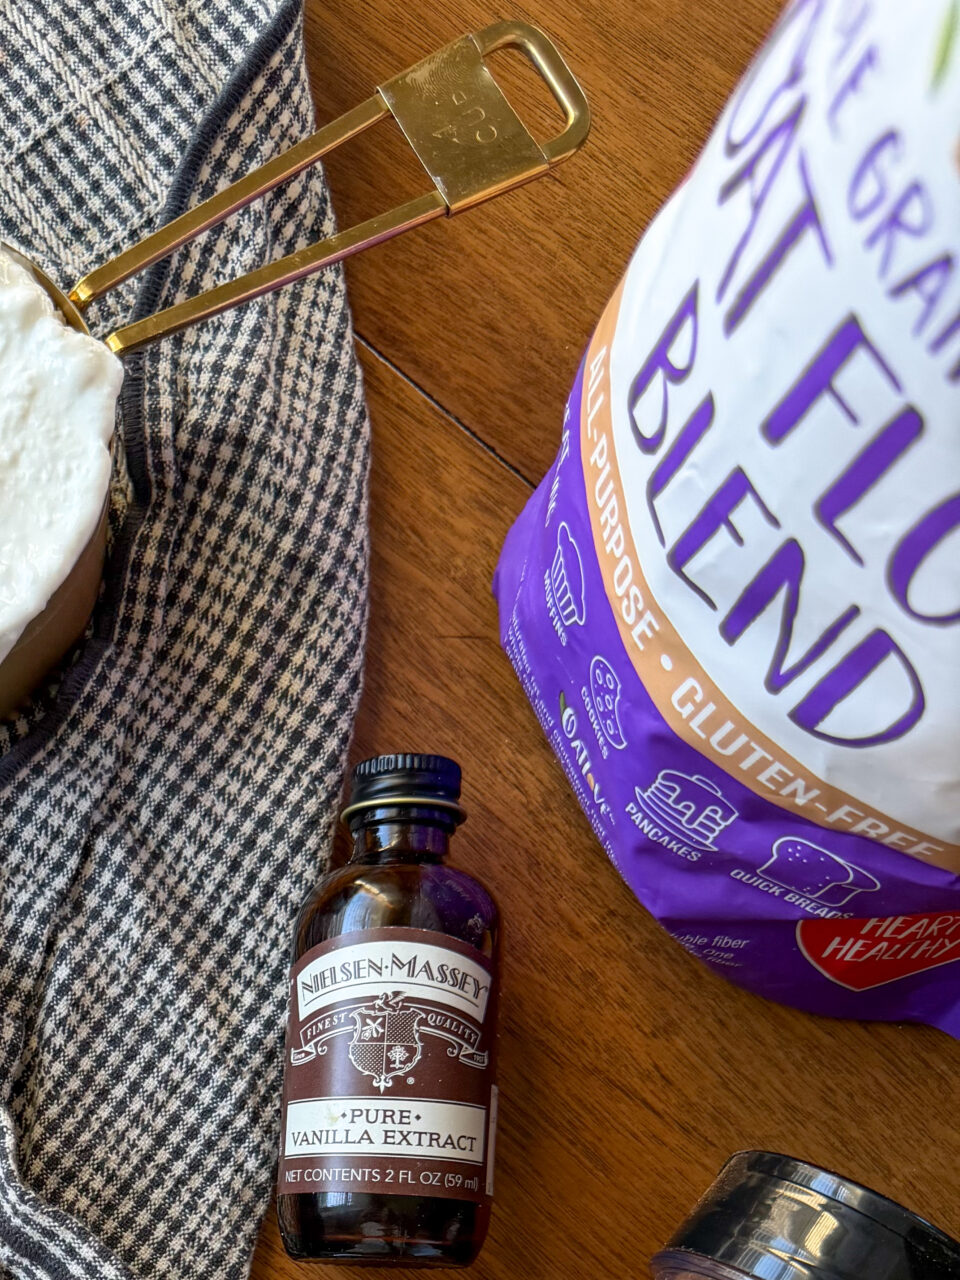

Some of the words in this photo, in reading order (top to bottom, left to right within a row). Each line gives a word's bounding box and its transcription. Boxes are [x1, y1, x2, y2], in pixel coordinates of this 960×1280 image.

[628, 278, 926, 749] BLEND
[543, 569, 568, 647] MUFFINS
[587, 345, 659, 650] ALL-PURPOSE
[669, 676, 944, 862] GLUTEN-FREE
[581, 686, 608, 759] COOKIES
[625, 802, 702, 861] PANCAKES
[730, 868, 785, 896] QUICK
[860, 915, 960, 939] HEART
[711, 934, 749, 950] fiber
[821, 936, 960, 962] HEALTHY
[306, 1012, 348, 1040] FINEST
[428, 1013, 478, 1043] QUALITY
[349, 1108, 413, 1125] PURE
[291, 1129, 375, 1147] VANILLA
[381, 1130, 477, 1152] EXTRACT
[285, 1169, 302, 1181] NET
[304, 1168, 381, 1182] CONTENTS
[385, 1169, 394, 1183] 2
[399, 1170, 416, 1185] FL
[419, 1171, 441, 1186] OZ
[444, 1172, 463, 1188] (59
[464, 1174, 479, 1192] ml)
